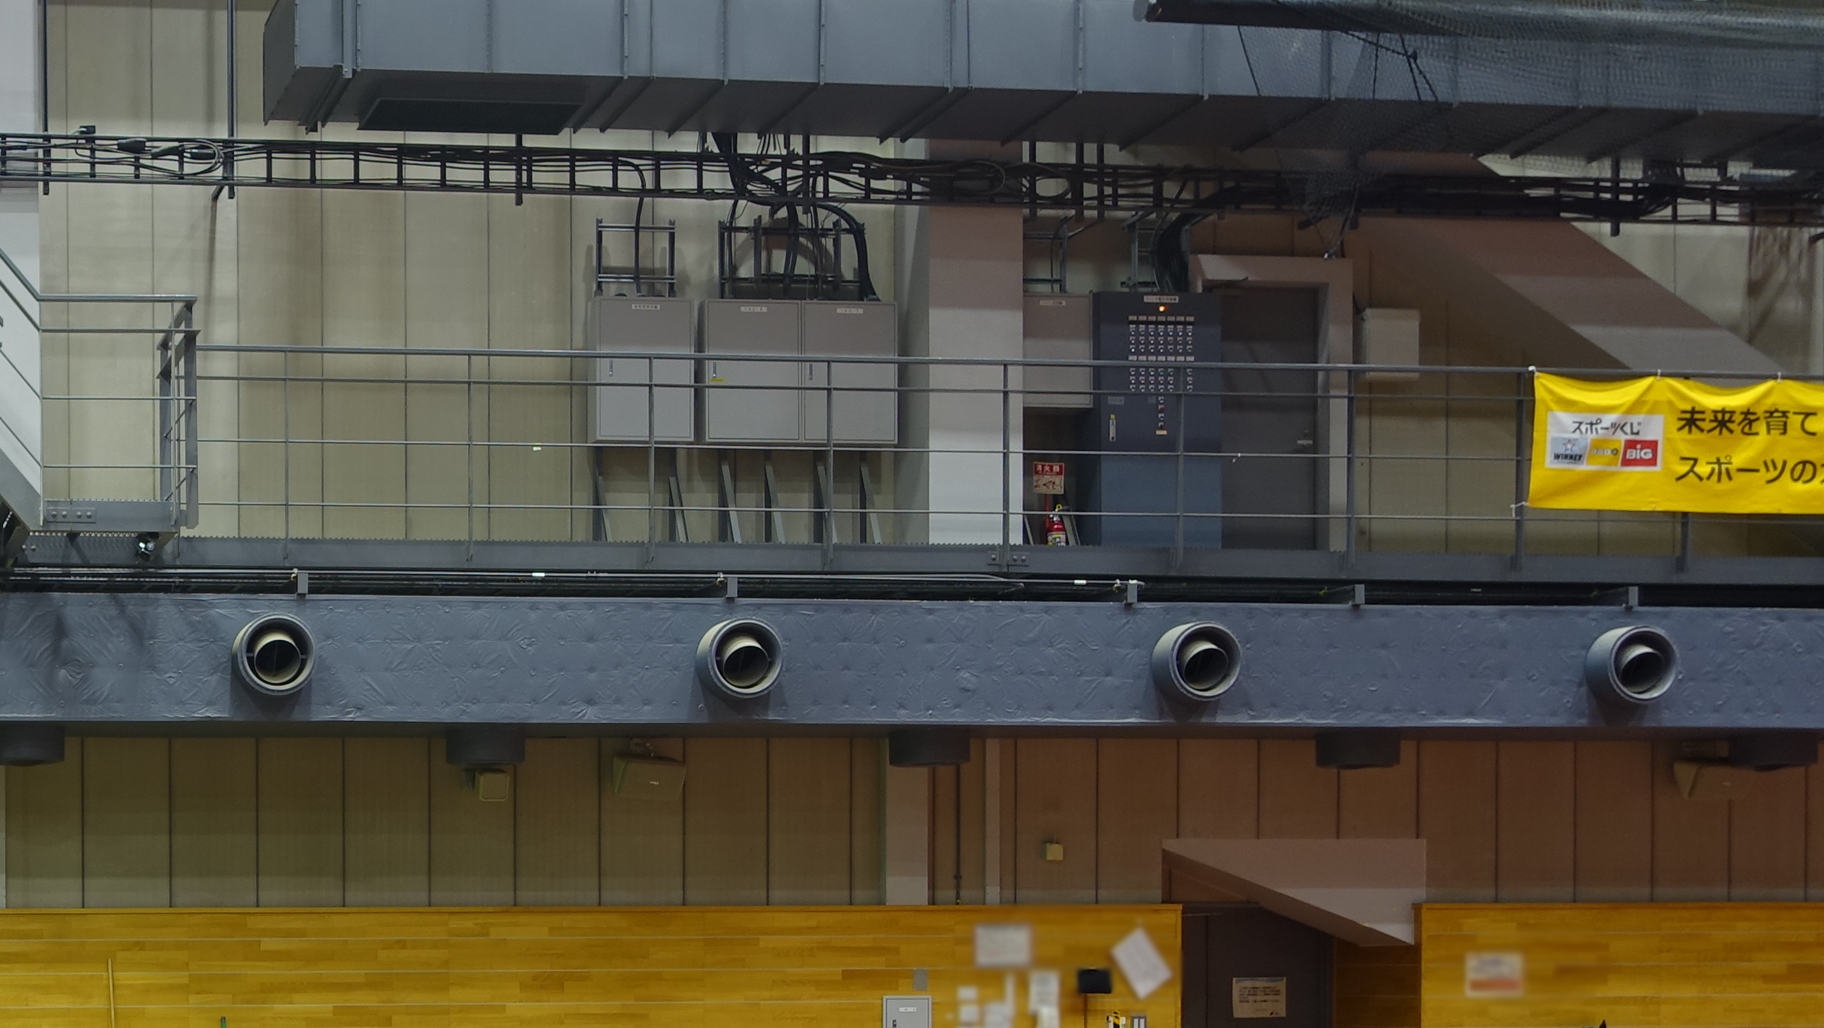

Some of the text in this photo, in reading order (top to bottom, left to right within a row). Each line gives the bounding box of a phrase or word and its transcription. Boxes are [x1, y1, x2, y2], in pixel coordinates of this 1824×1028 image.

[1571, 417, 1642, 436] スポーツくじ
[1676, 405, 1818, 436] 未来を育て
[1675, 454, 1824, 484] スポーツの
